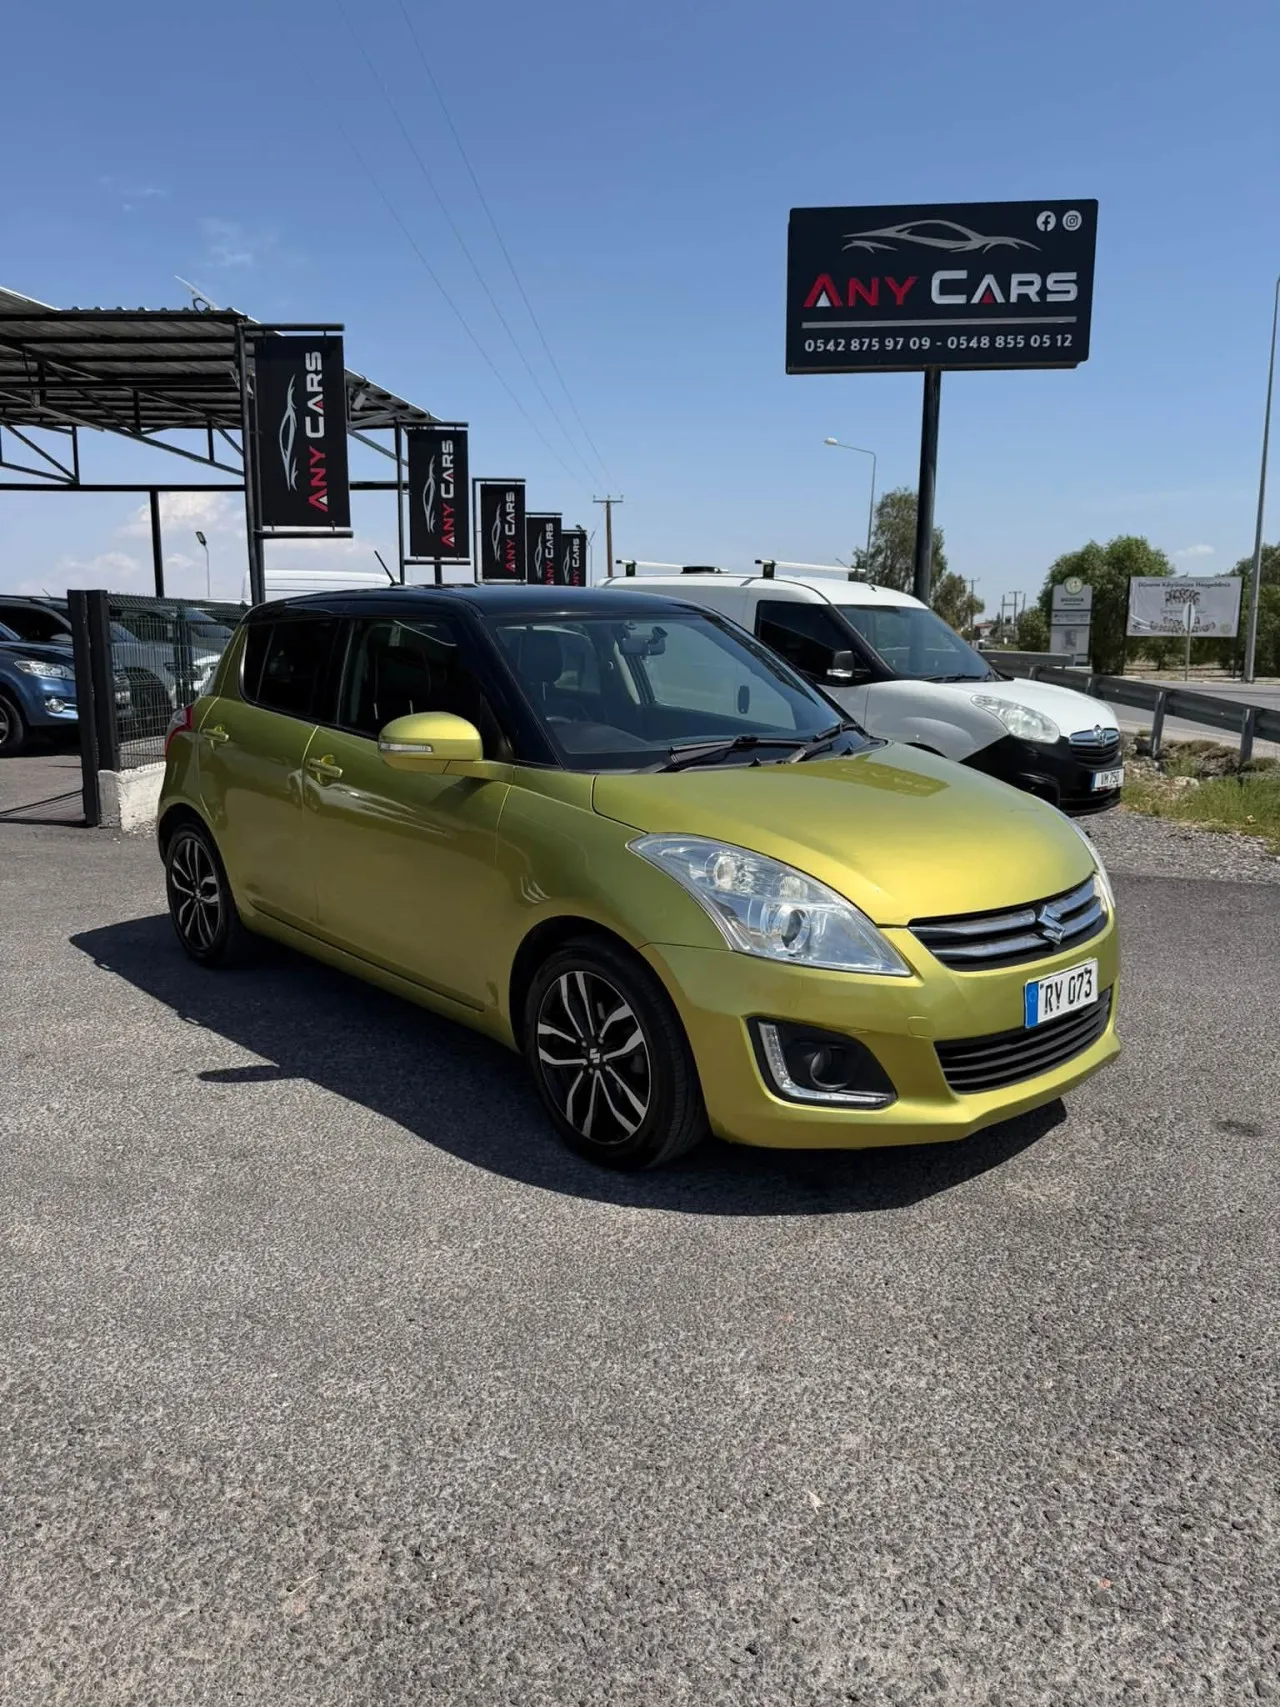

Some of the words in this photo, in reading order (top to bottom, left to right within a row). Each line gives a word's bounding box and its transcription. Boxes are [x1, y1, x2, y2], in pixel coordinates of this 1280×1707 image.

[803, 273, 918, 307] ANY
[931, 269, 1078, 305] CARS
[804, 339, 846, 352] 0542
[850, 338, 880, 351] 875
[884, 337, 904, 350] 97
[909, 336, 931, 350] 09
[947, 335, 990, 349] 0548
[995, 335, 1025, 348] 855
[1030, 334, 1051, 347] 05
[1055, 334, 1073, 347] 12
[305, 351, 325, 439] CARS
[308, 445, 329, 512] ANY
[440, 439, 454, 498] CARS
[440, 502, 455, 548] ANY
[505, 491, 516, 535] CARS
[504, 538, 516, 573] ANY
[545, 522, 554, 558] CARS
[572, 537, 580, 568] CARS
[572, 569, 580, 587] NY
[1044, 980, 1063, 1015] RY
[1068, 967, 1092, 1005] 073
